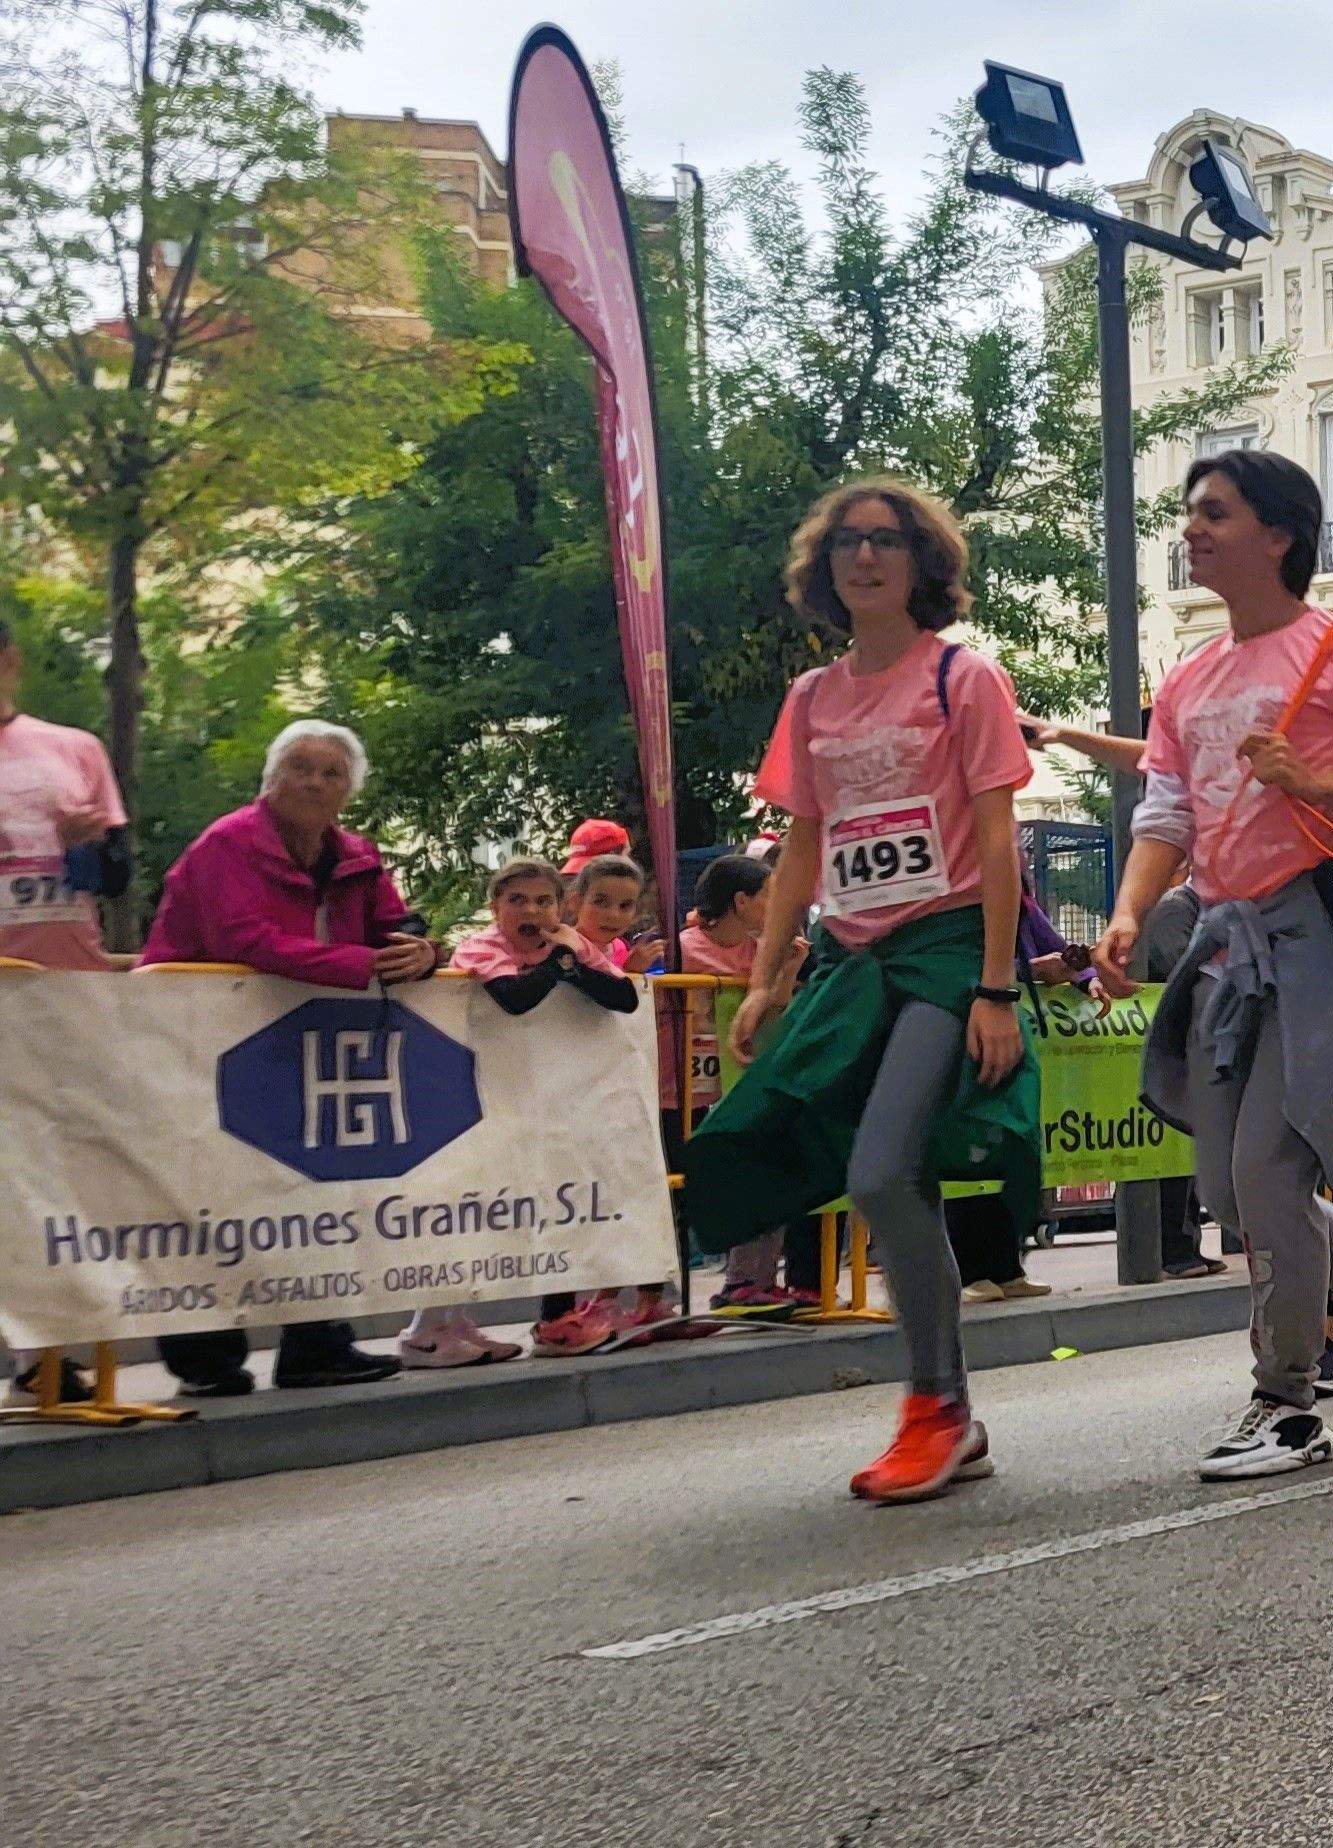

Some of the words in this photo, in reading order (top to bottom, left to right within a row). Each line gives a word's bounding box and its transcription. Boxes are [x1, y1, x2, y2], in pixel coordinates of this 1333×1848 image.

[833, 835, 932, 888] 1493
[44, 1207, 360, 1268] Hormigones
[375, 1186, 548, 1241] Grañén,
[555, 1181, 623, 1226] S.L.
[237, 1270, 365, 1308] ASFALTOS
[383, 1259, 465, 1293] OBRAS
[471, 1249, 571, 1283] PÚBLICAS
